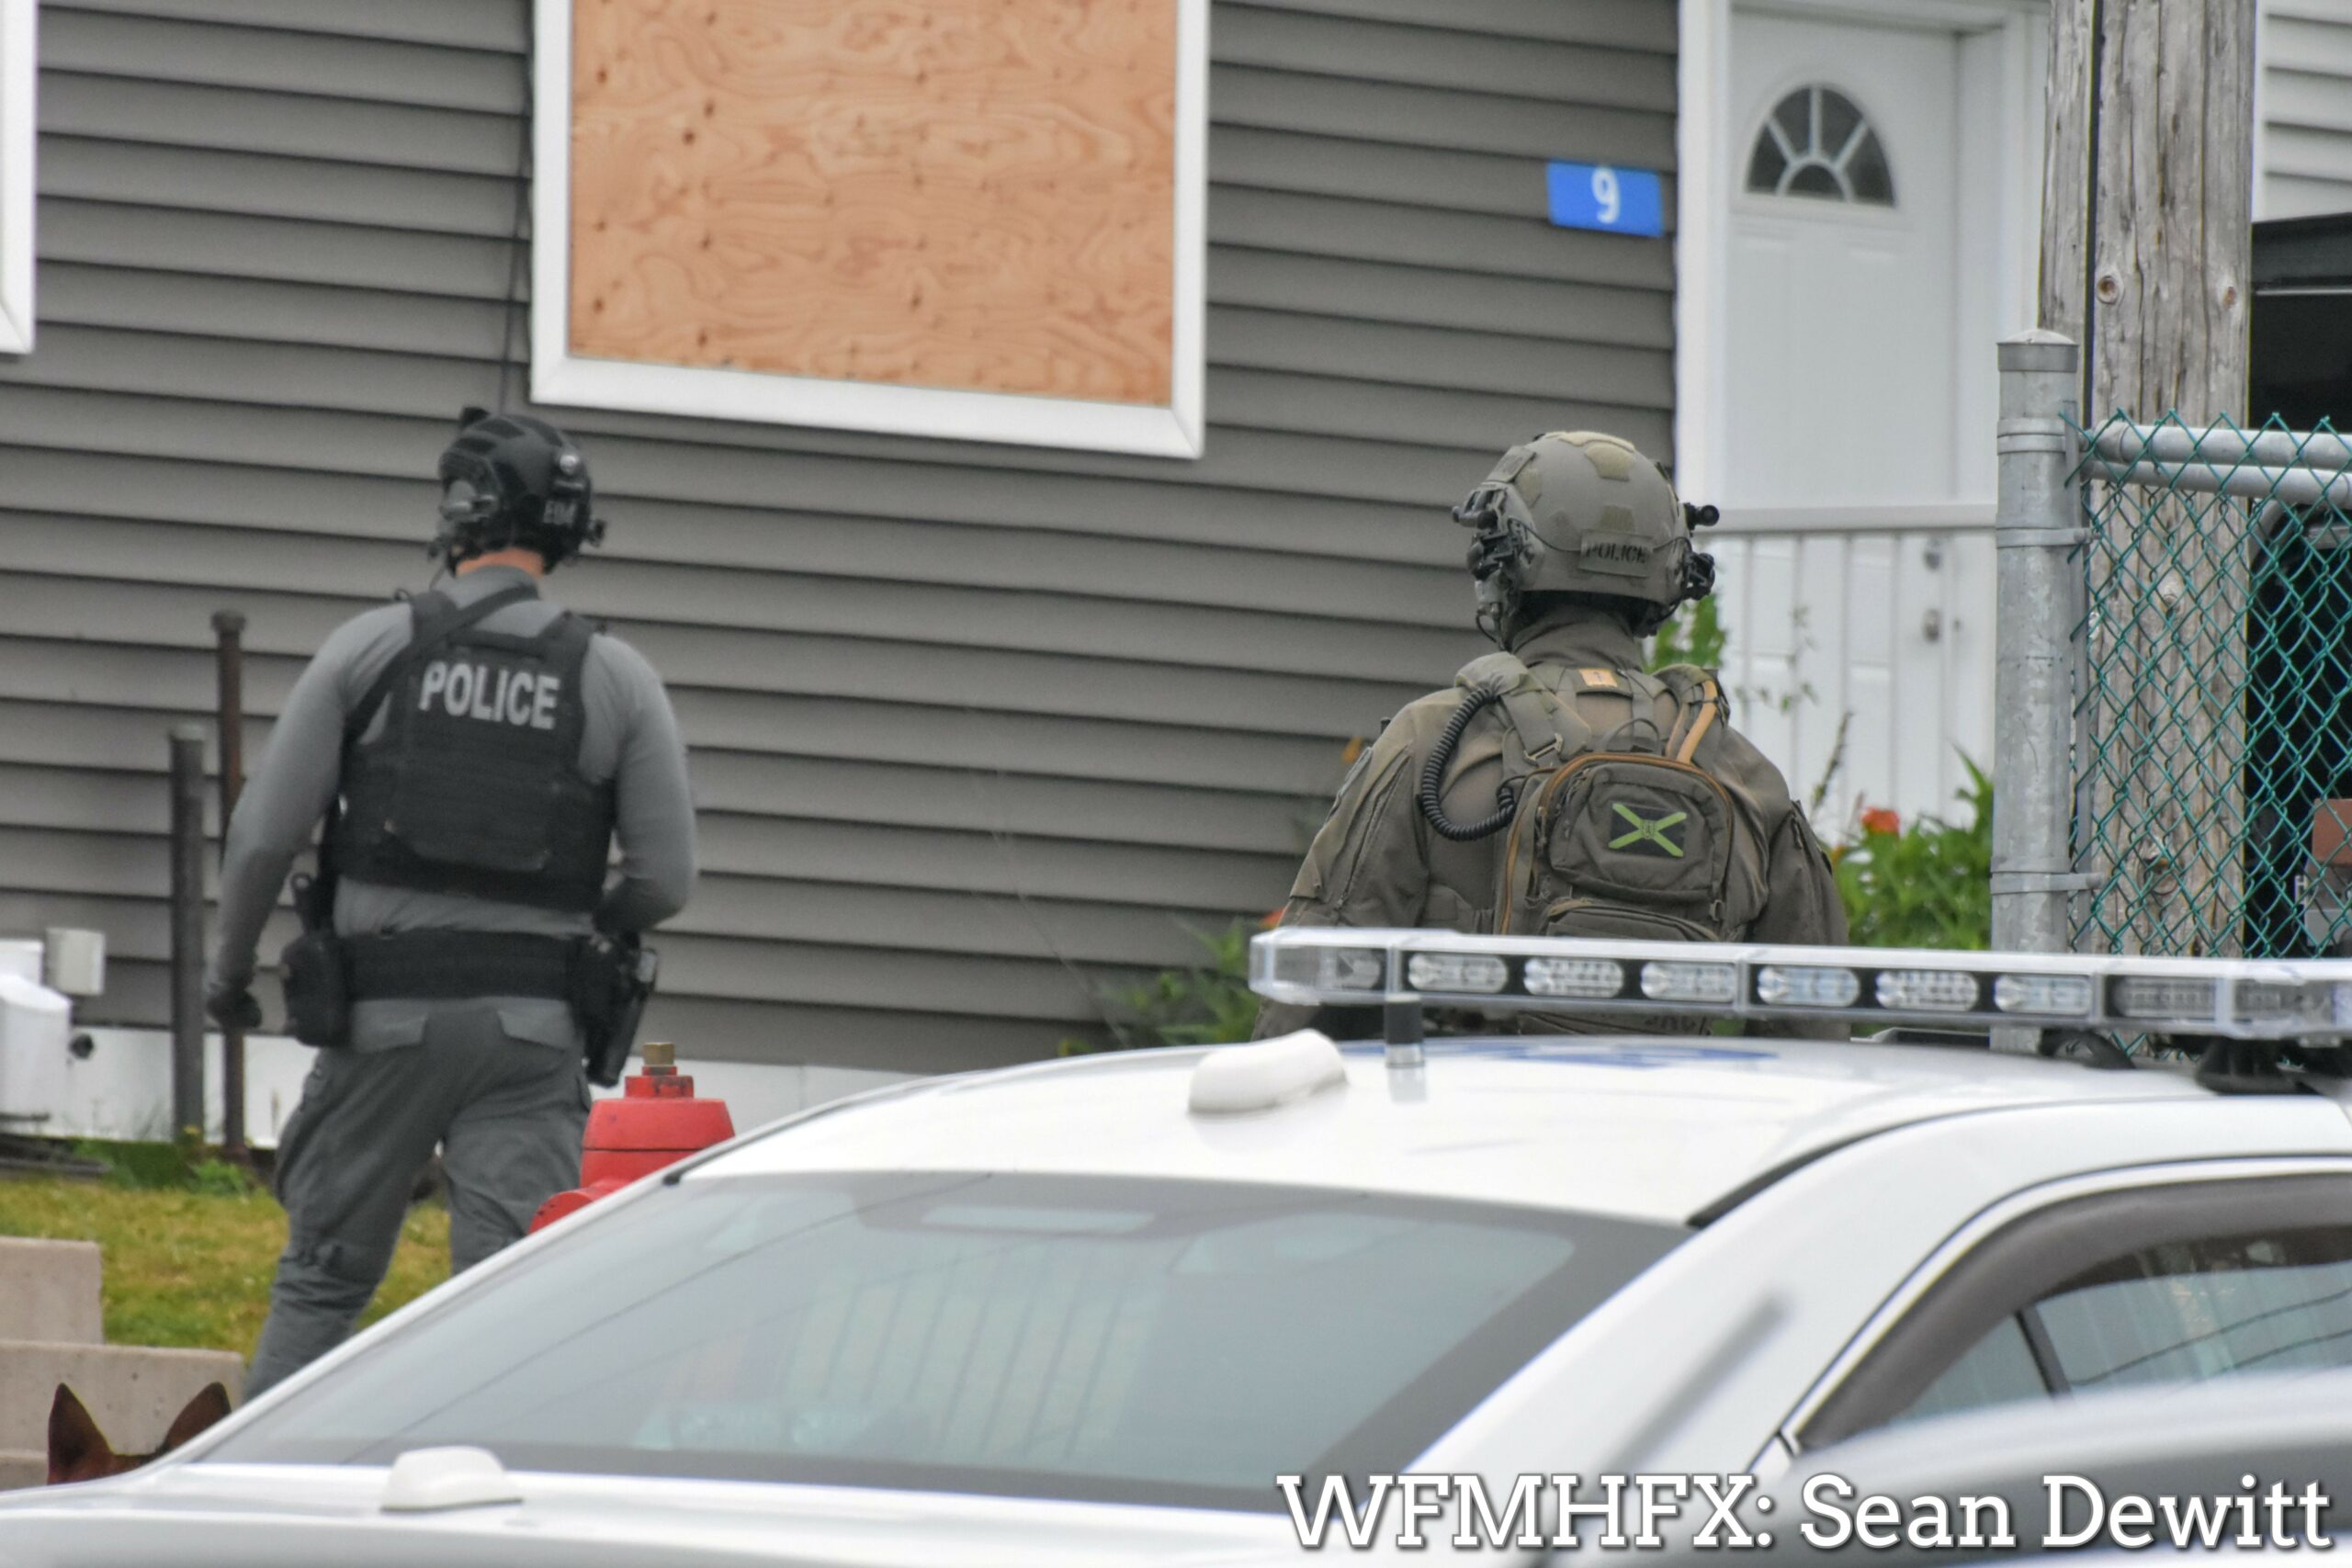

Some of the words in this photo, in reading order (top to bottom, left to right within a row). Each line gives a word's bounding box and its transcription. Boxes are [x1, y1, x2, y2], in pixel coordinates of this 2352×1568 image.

[1591, 166, 1620, 223] 9
[1585, 542, 1647, 564] POLICE
[418, 660, 560, 729] POLICE
